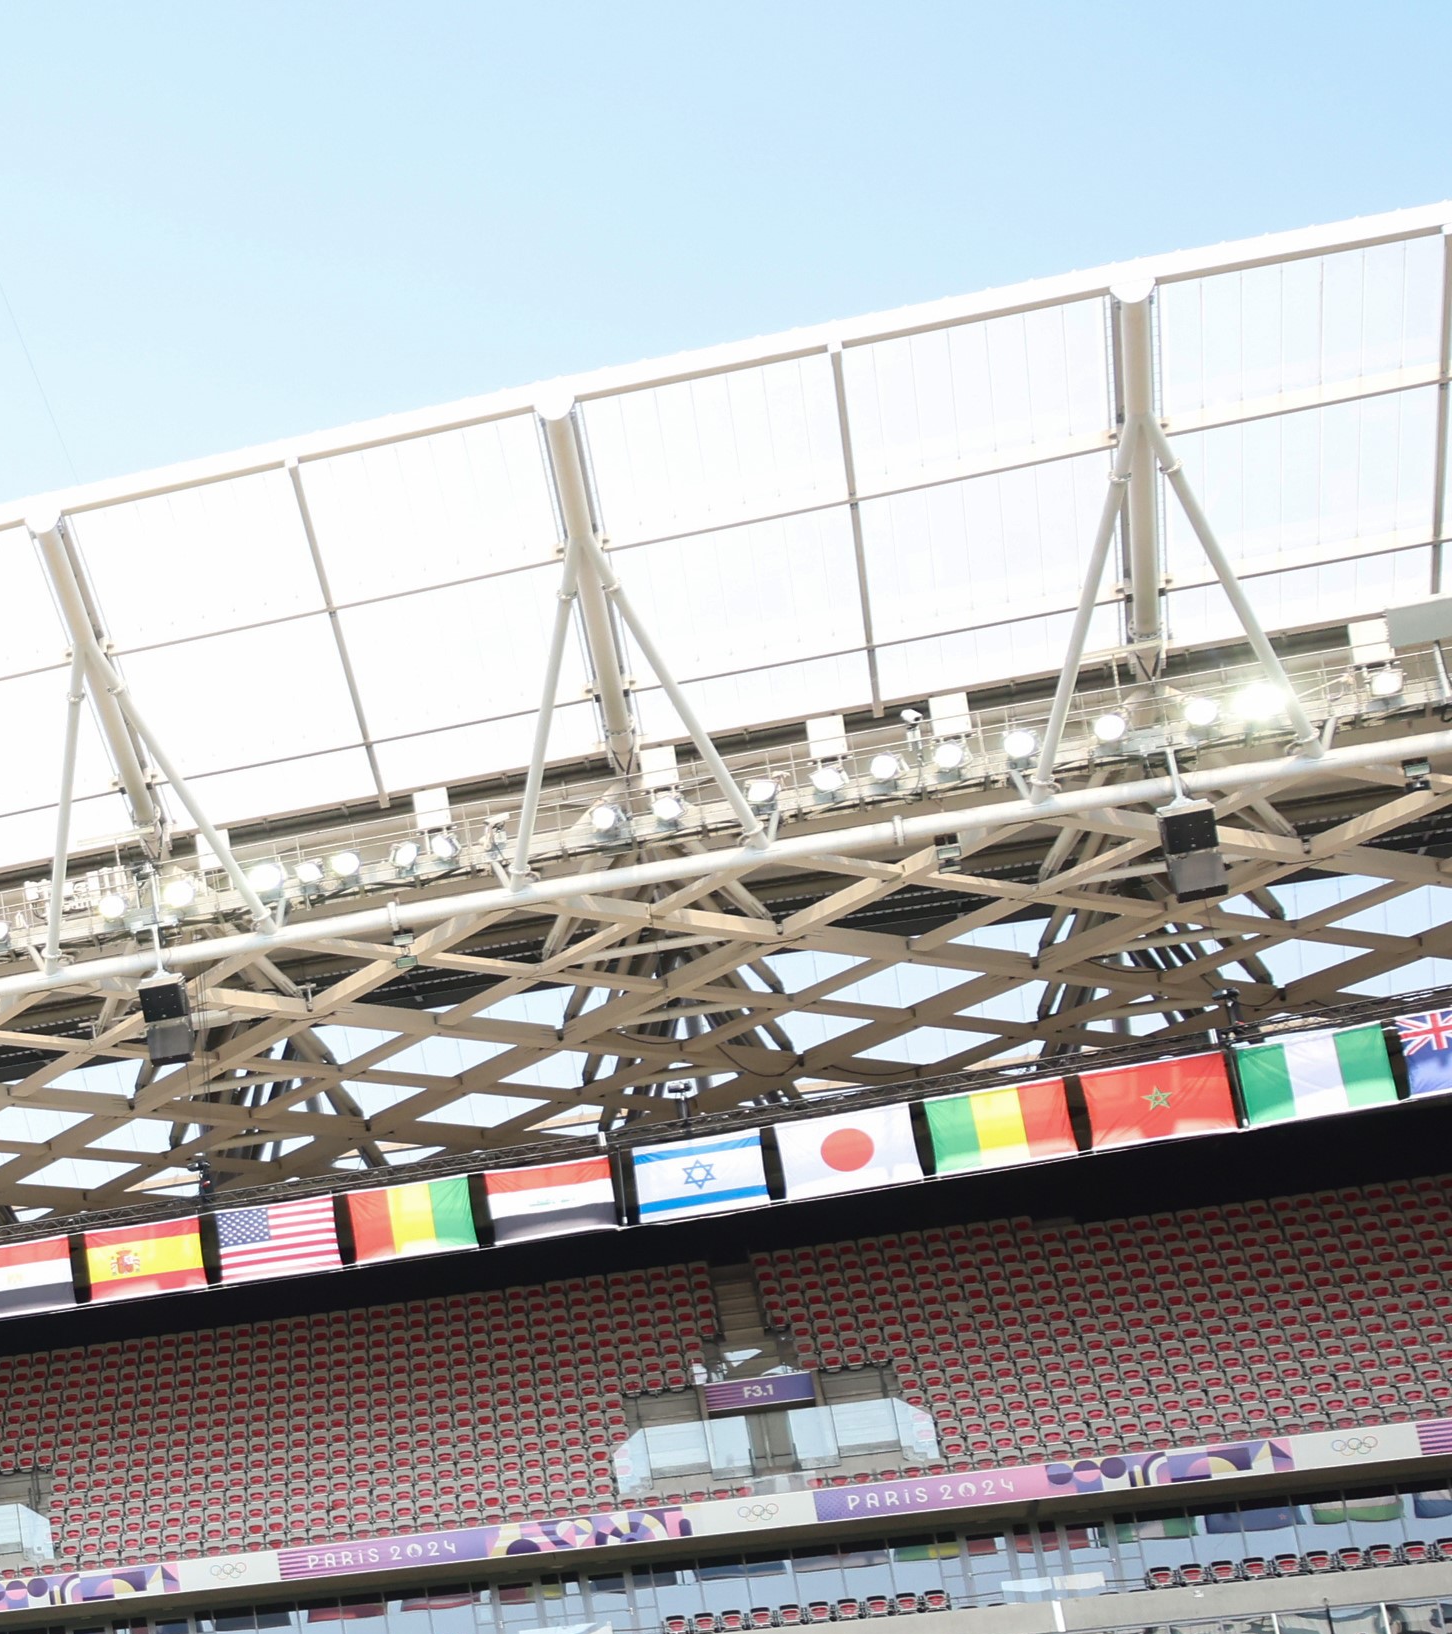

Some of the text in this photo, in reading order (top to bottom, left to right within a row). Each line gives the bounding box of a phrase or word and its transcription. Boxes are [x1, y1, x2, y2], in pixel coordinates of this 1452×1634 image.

[743, 1383, 773, 1399] F3.1
[938, 1478, 1014, 1501] 2024
[390, 1539, 456, 1561] 2024
